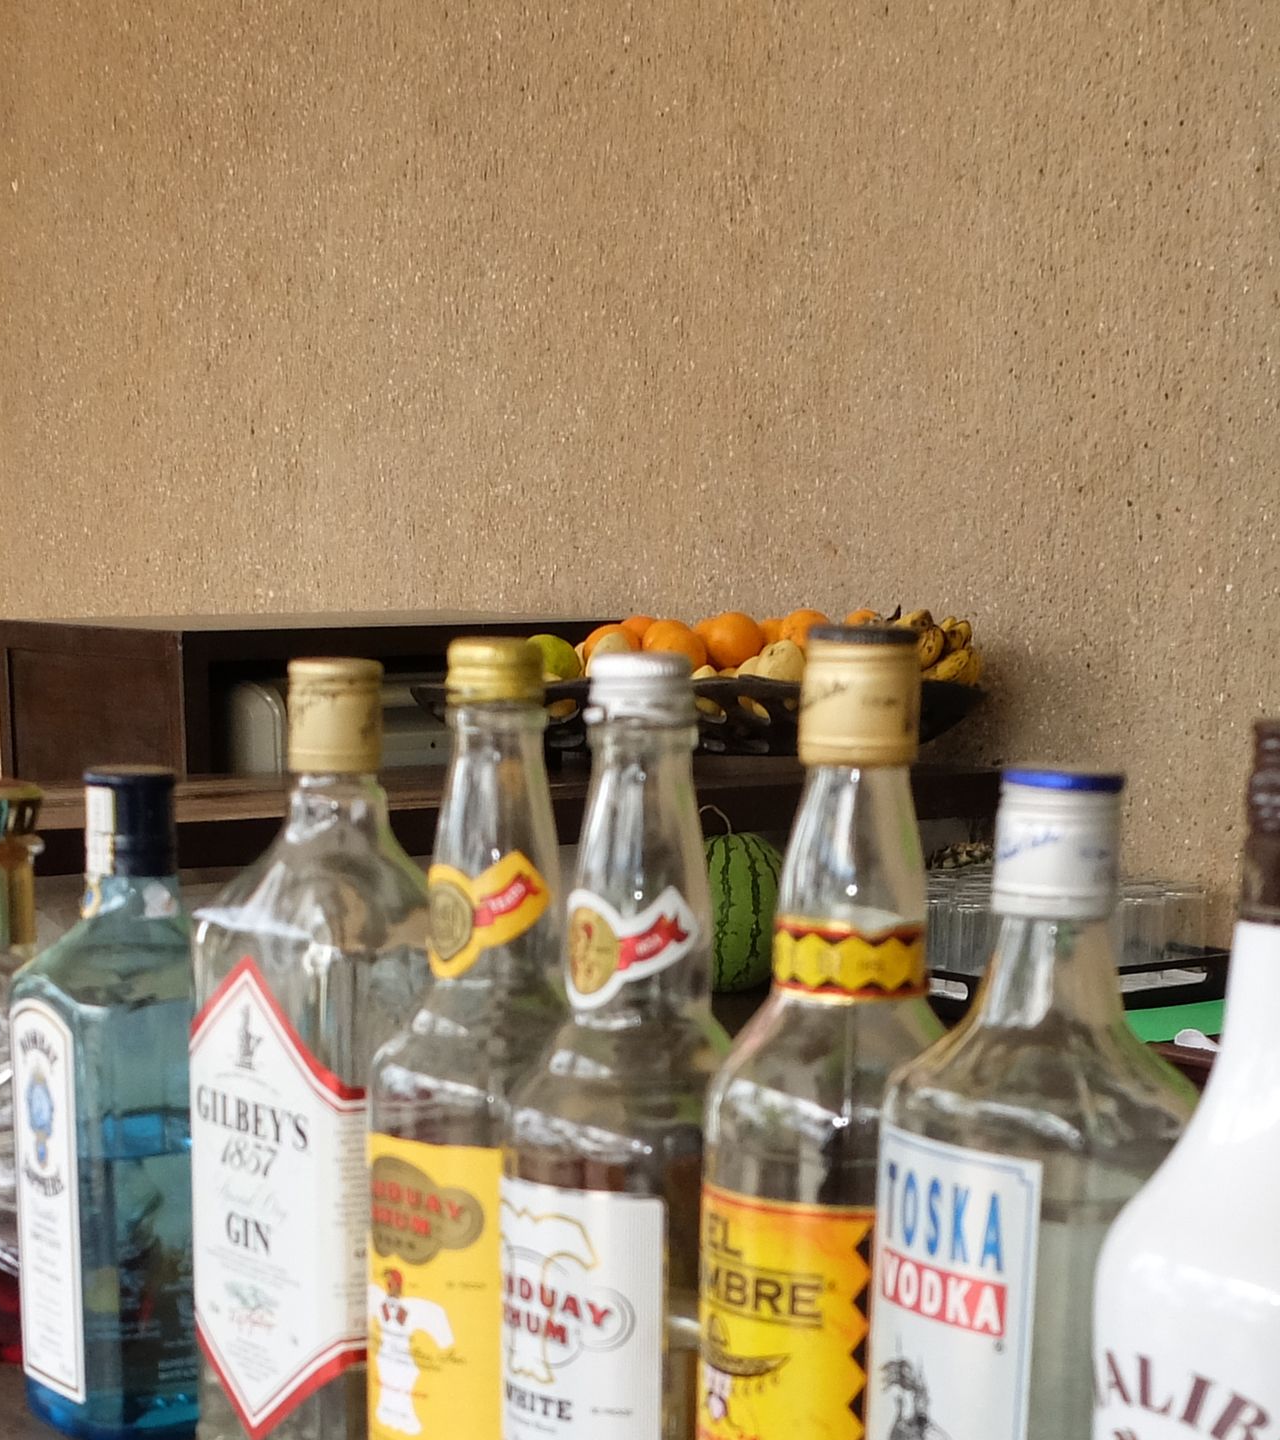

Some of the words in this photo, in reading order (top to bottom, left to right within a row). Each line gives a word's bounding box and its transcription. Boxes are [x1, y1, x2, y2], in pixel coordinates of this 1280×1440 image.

[196, 1084, 308, 1152] GILBEY'S
[221, 1137, 278, 1177] 1857
[225, 1209, 272, 1256] GIN
[886, 1162, 1003, 1274] TOSKA
[881, 1254, 1002, 1335] VODKA
